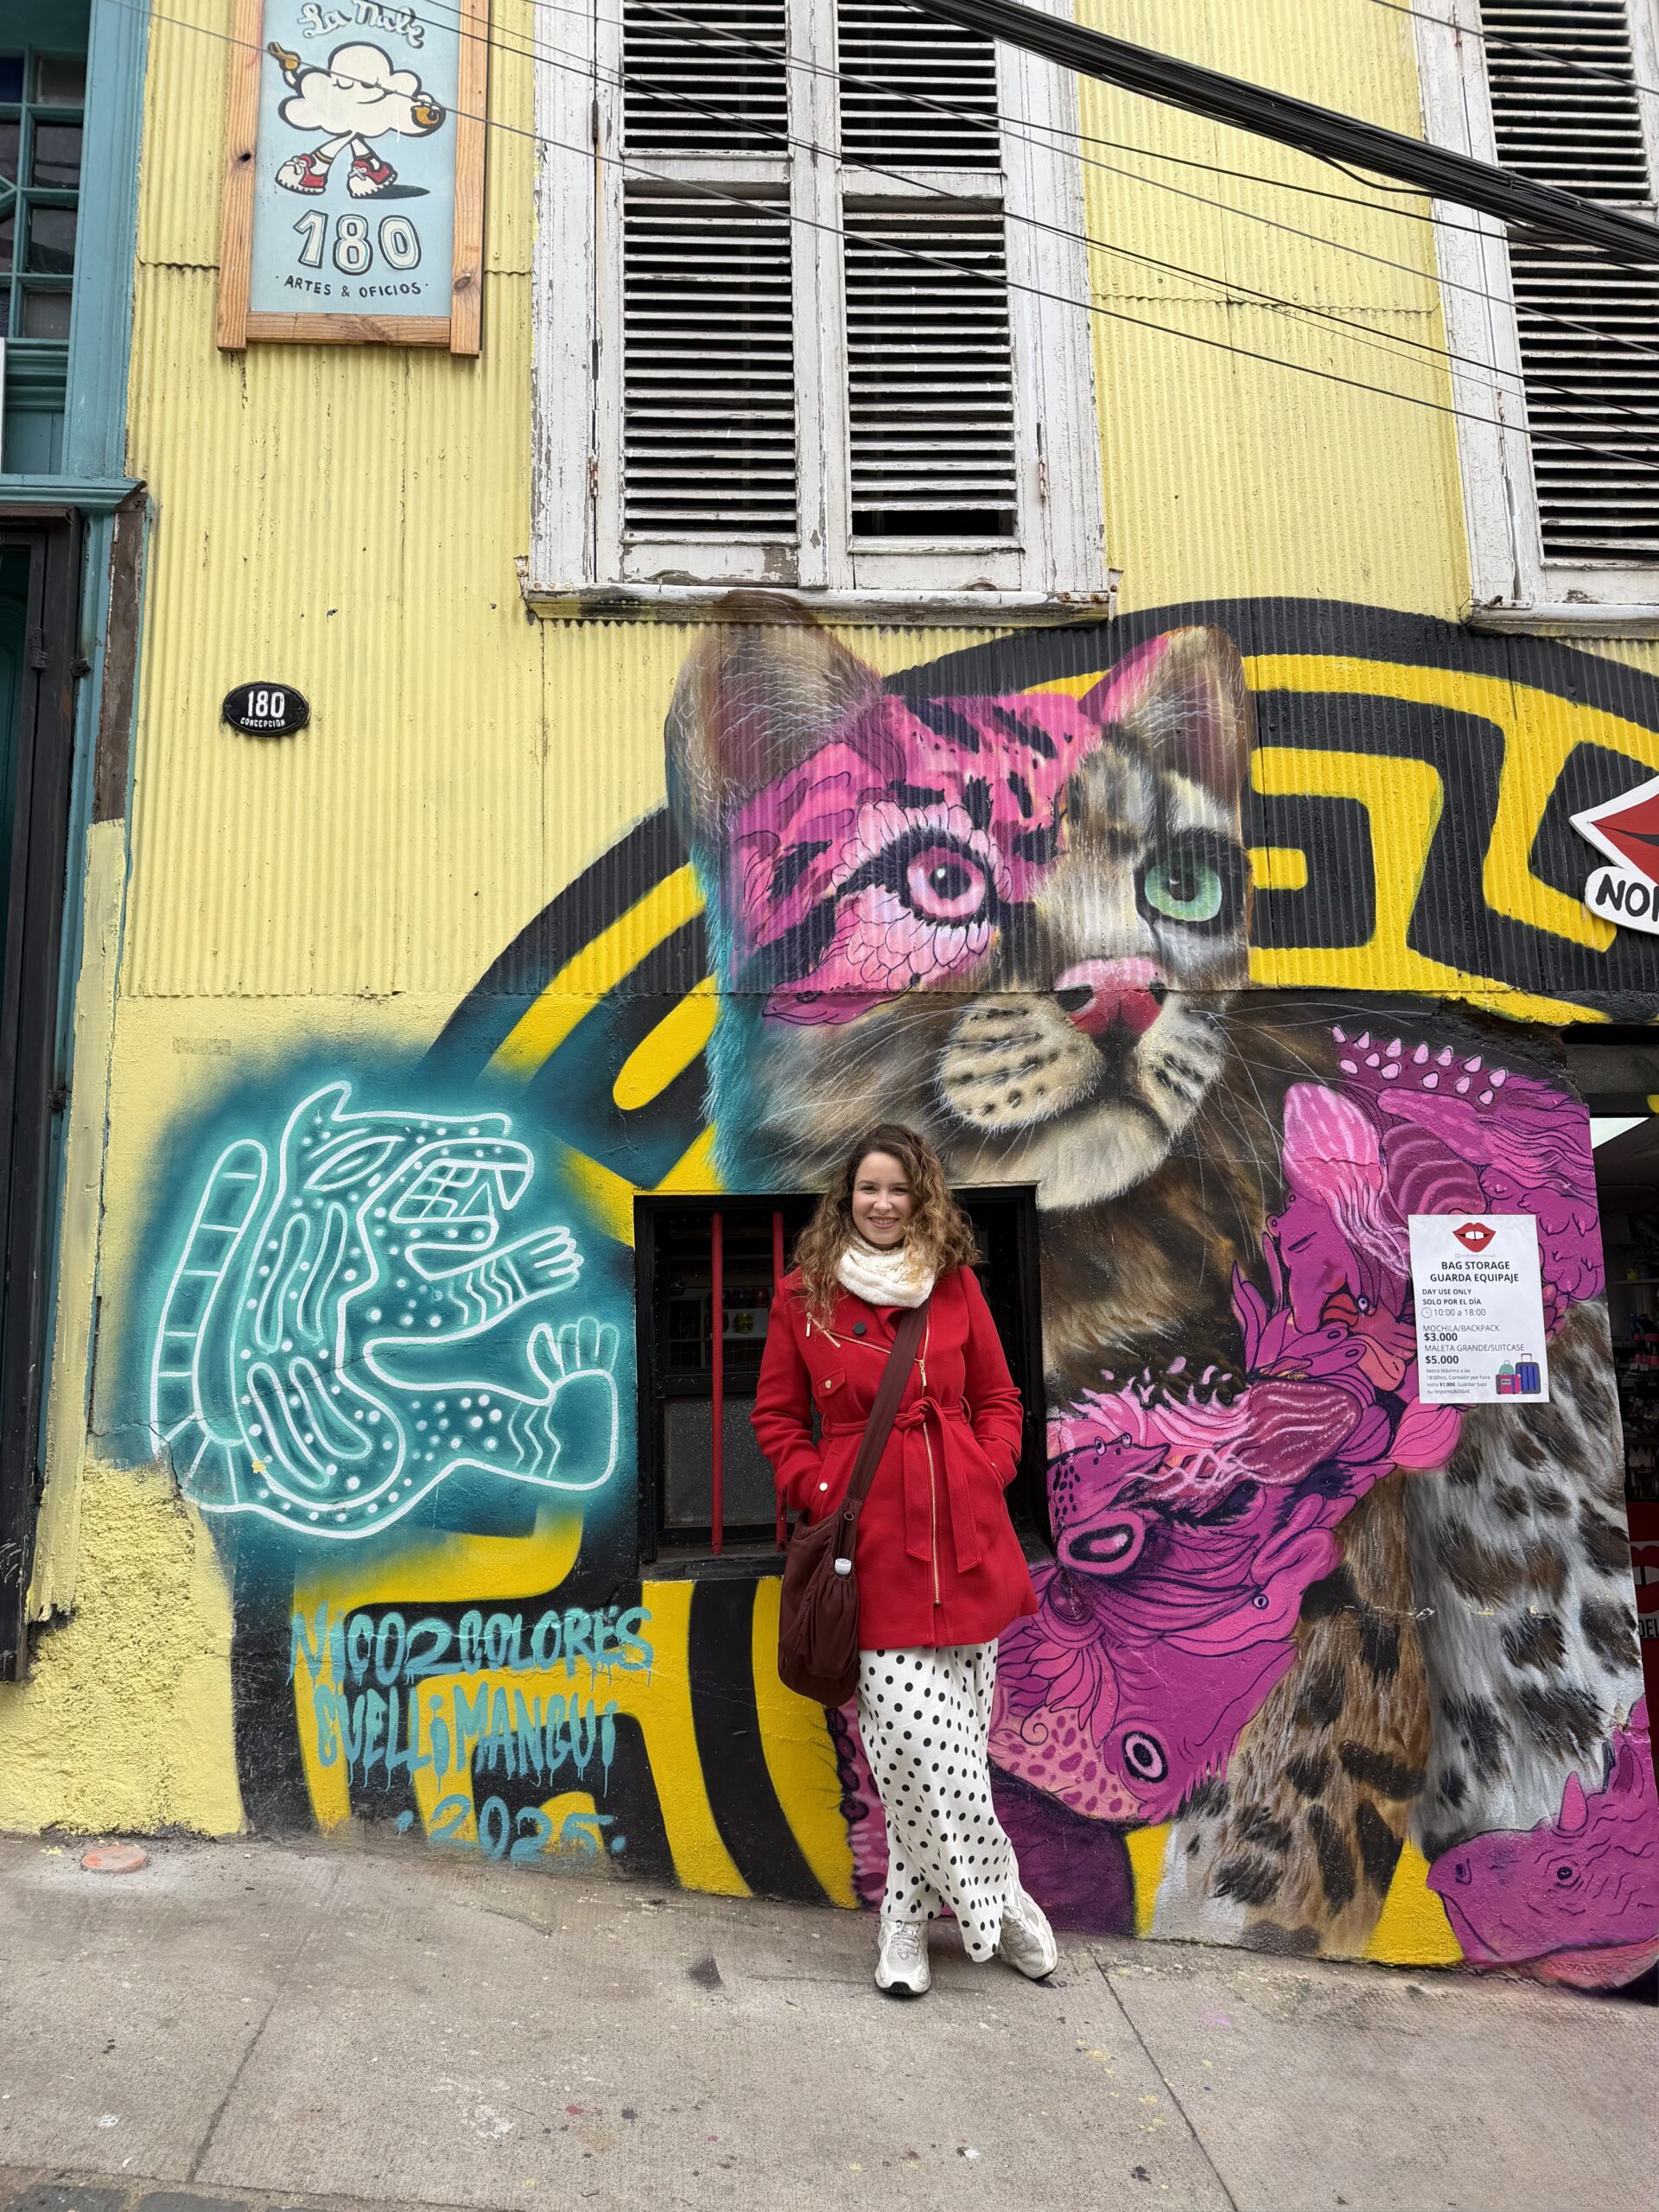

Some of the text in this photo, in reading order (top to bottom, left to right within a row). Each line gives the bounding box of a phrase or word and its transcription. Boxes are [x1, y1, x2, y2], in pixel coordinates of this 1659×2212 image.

[296, 3, 352, 39] La
[293, 209, 422, 276] 180
[283, 275, 421, 298] ARTES & OFICIOS
[248, 690, 285, 718] 180
[240, 717, 285, 728] CONCEPCION
[1441, 1261, 1510, 1270] BAG STORAGE
[1430, 1274, 1519, 1284] GUARDA EQUIPAJE
[1468, 1297, 1482, 1306] DÍA
[1434, 1308, 1456, 1317] 10:00
[1465, 1308, 1486, 1317] 18:00
[1424, 1332, 1458, 1342] $3.000
[1425, 1355, 1459, 1364] $5.000
